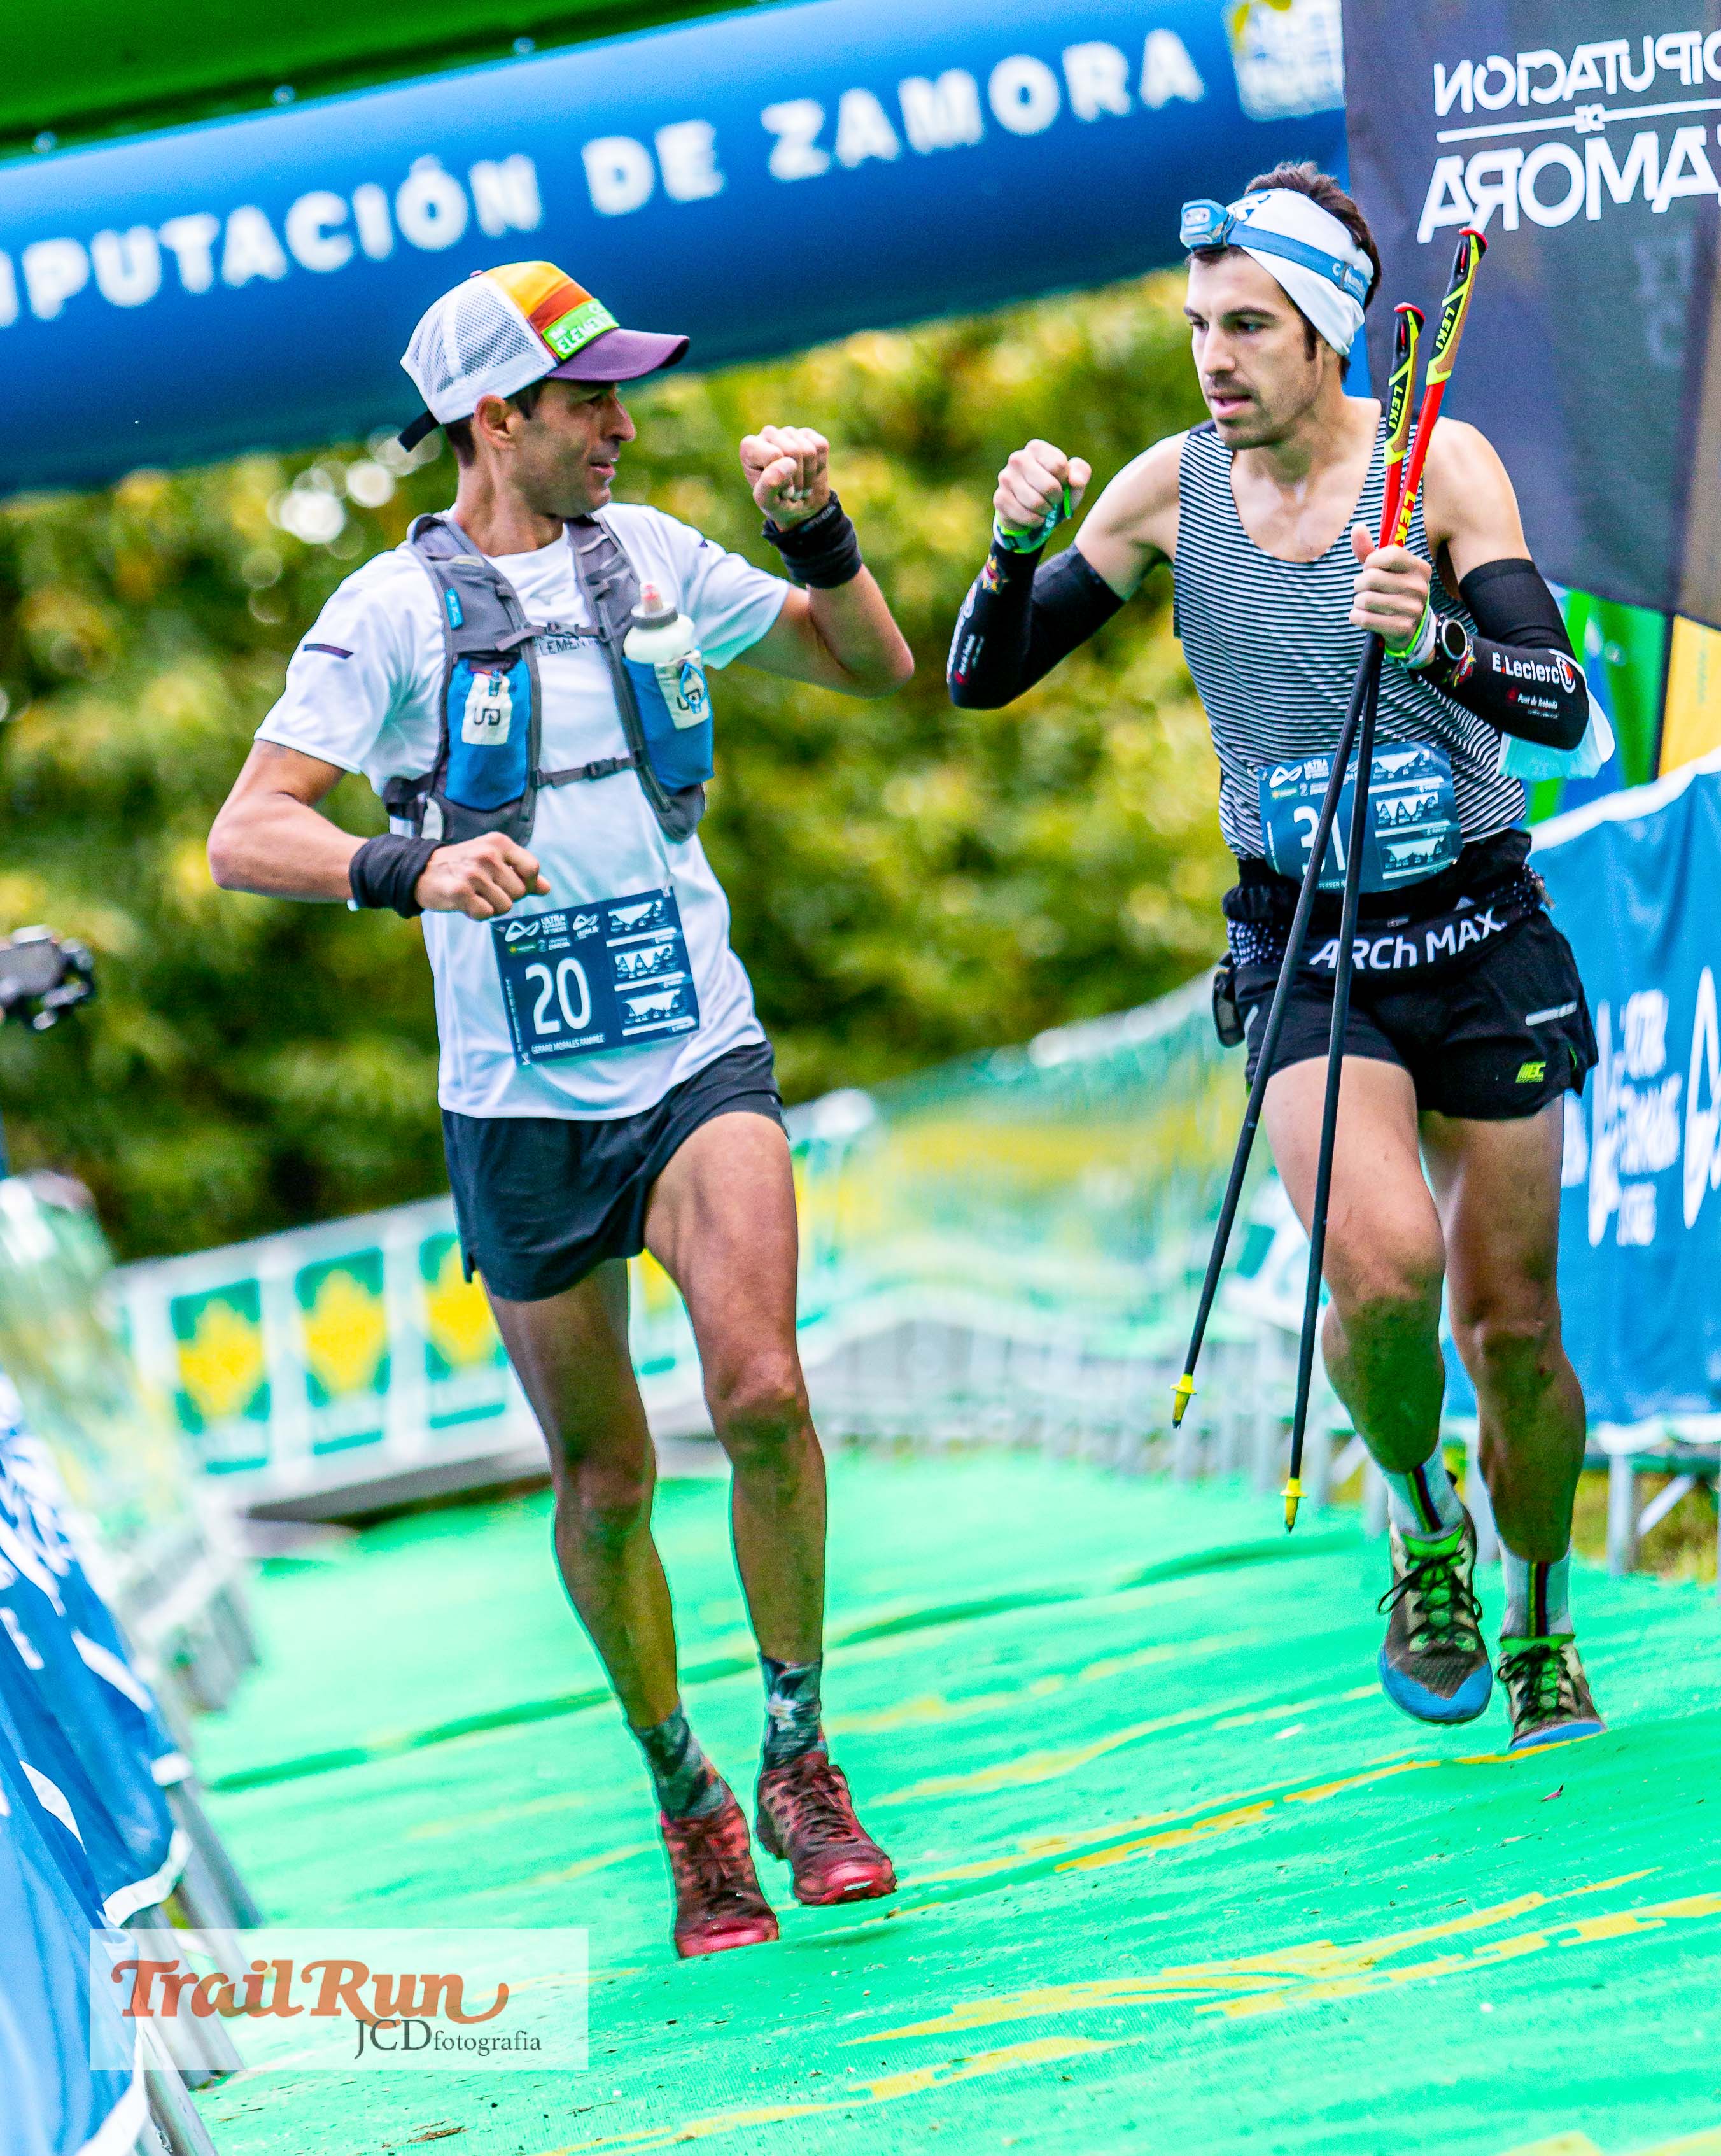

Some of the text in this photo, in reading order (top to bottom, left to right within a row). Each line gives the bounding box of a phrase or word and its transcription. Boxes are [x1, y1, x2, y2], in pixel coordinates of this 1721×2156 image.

[581, 119, 727, 217] DE
[761, 29, 1205, 181] ZAMORA
[1435, 306, 1455, 351] LEKI
[1388, 386, 1403, 430] LEKI
[1394, 490, 1416, 548] LEK
[1492, 651, 1560, 684] E.Leclerc
[1426, 906, 1501, 964] MAX
[525, 957, 592, 1035] 20
